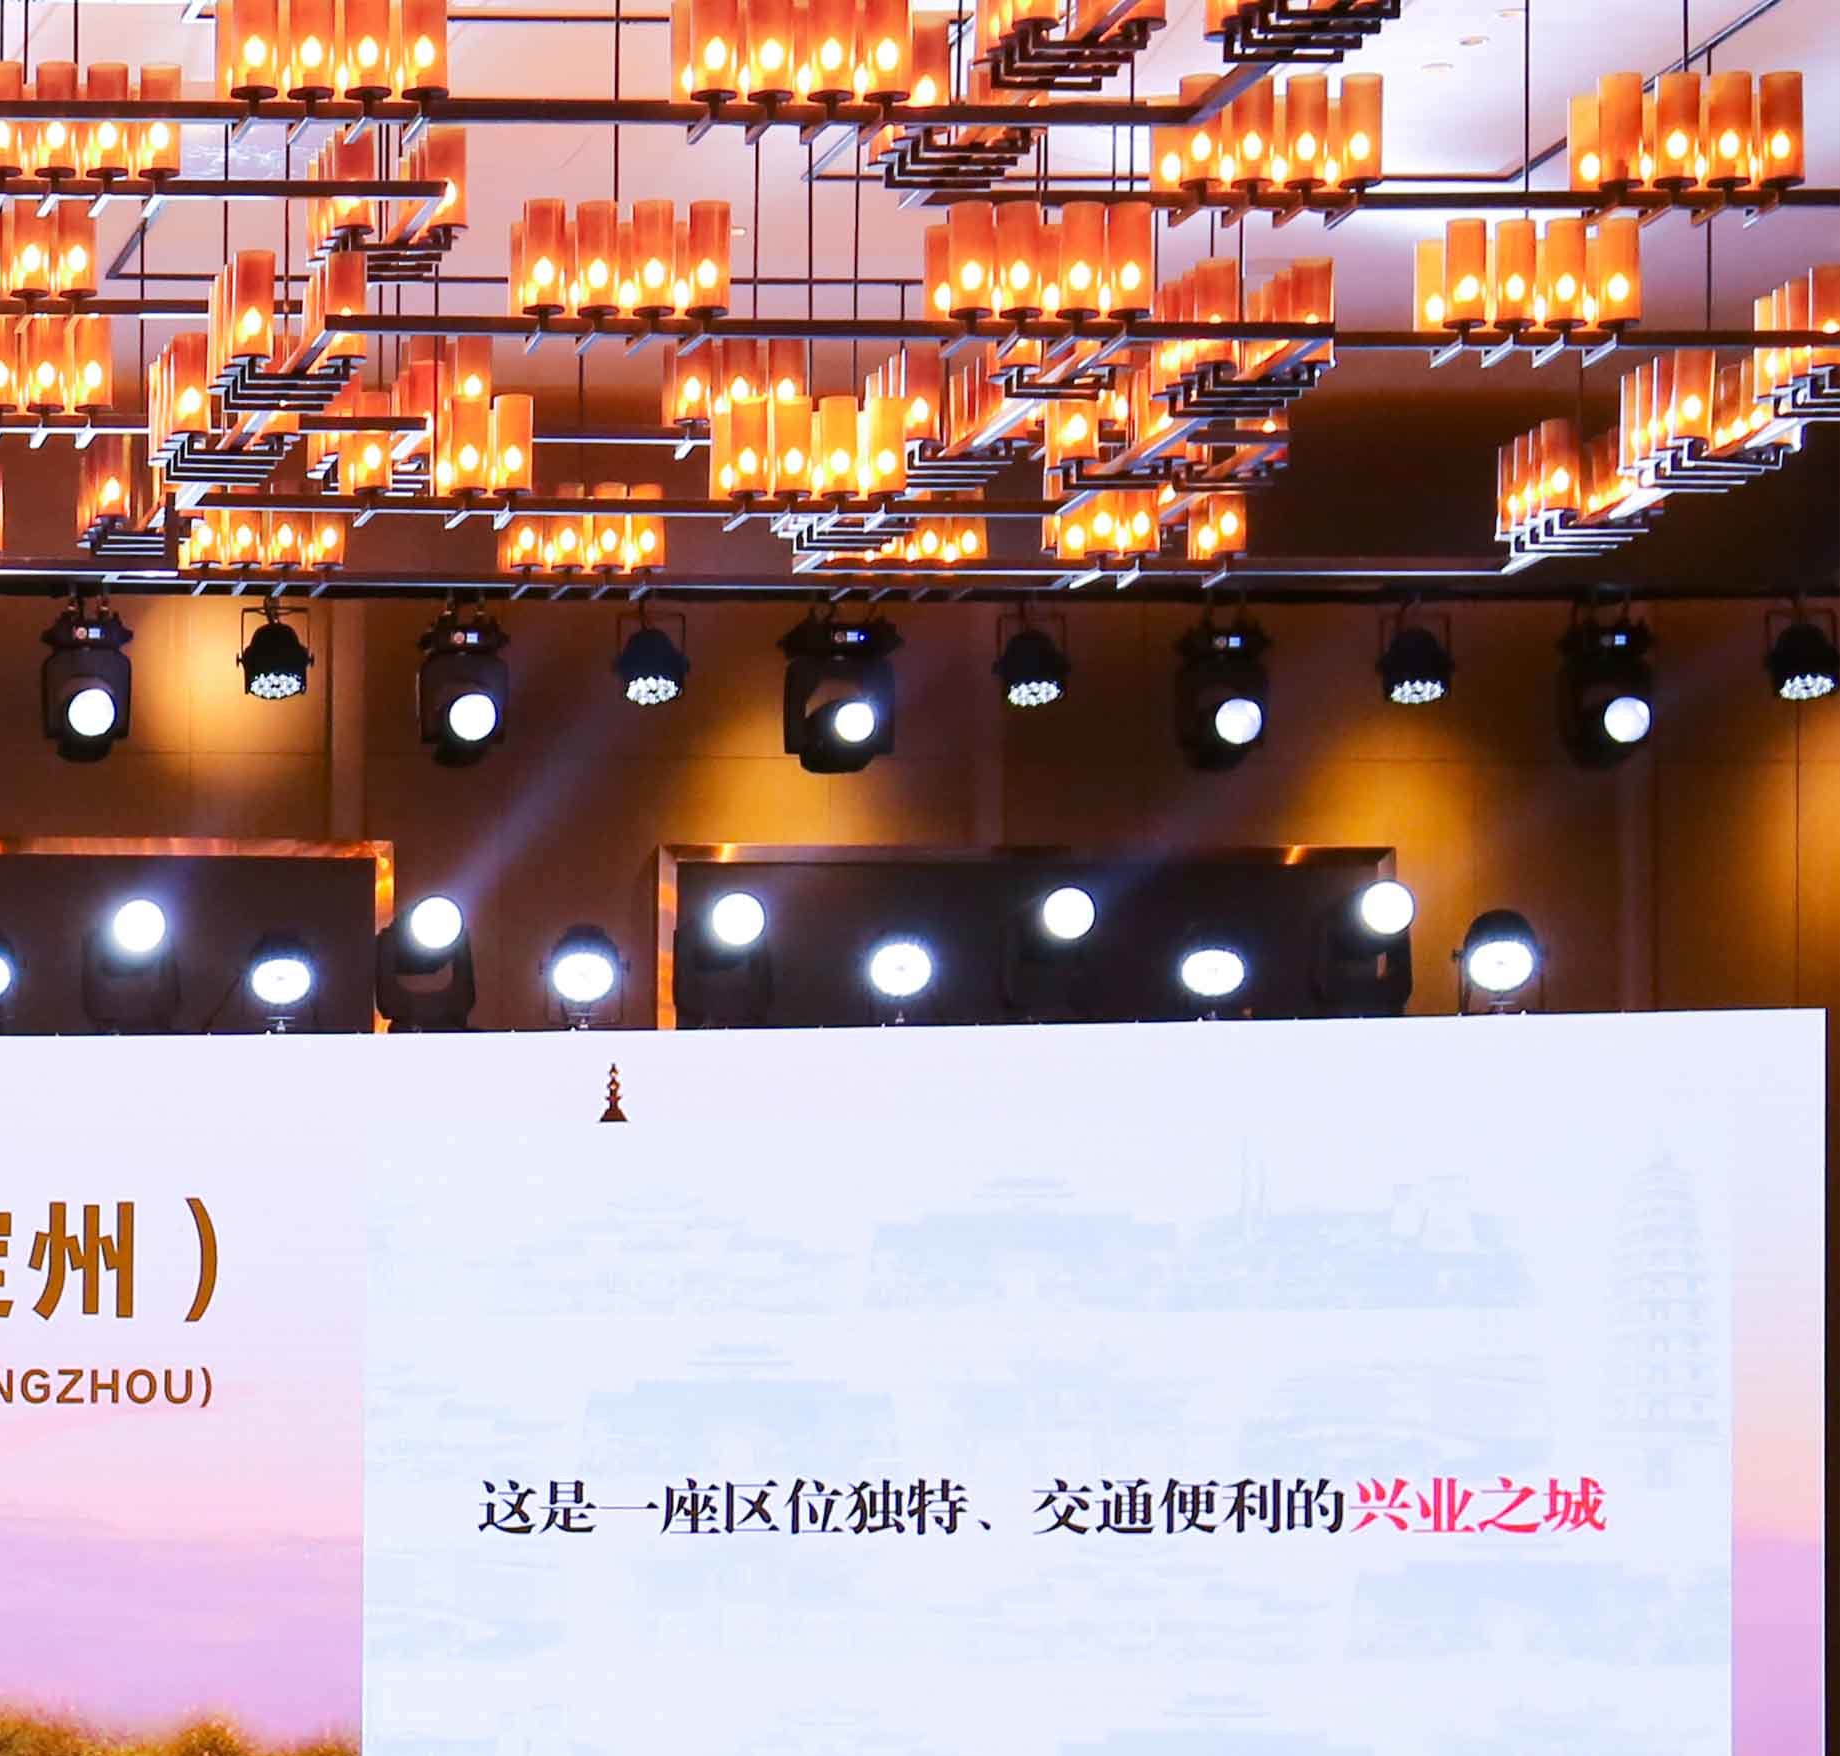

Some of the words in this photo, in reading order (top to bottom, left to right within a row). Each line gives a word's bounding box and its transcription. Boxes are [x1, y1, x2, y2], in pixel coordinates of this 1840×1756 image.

[477, 1475, 1609, 1538] 这是一座区位独特、交通便利的兴业之城
